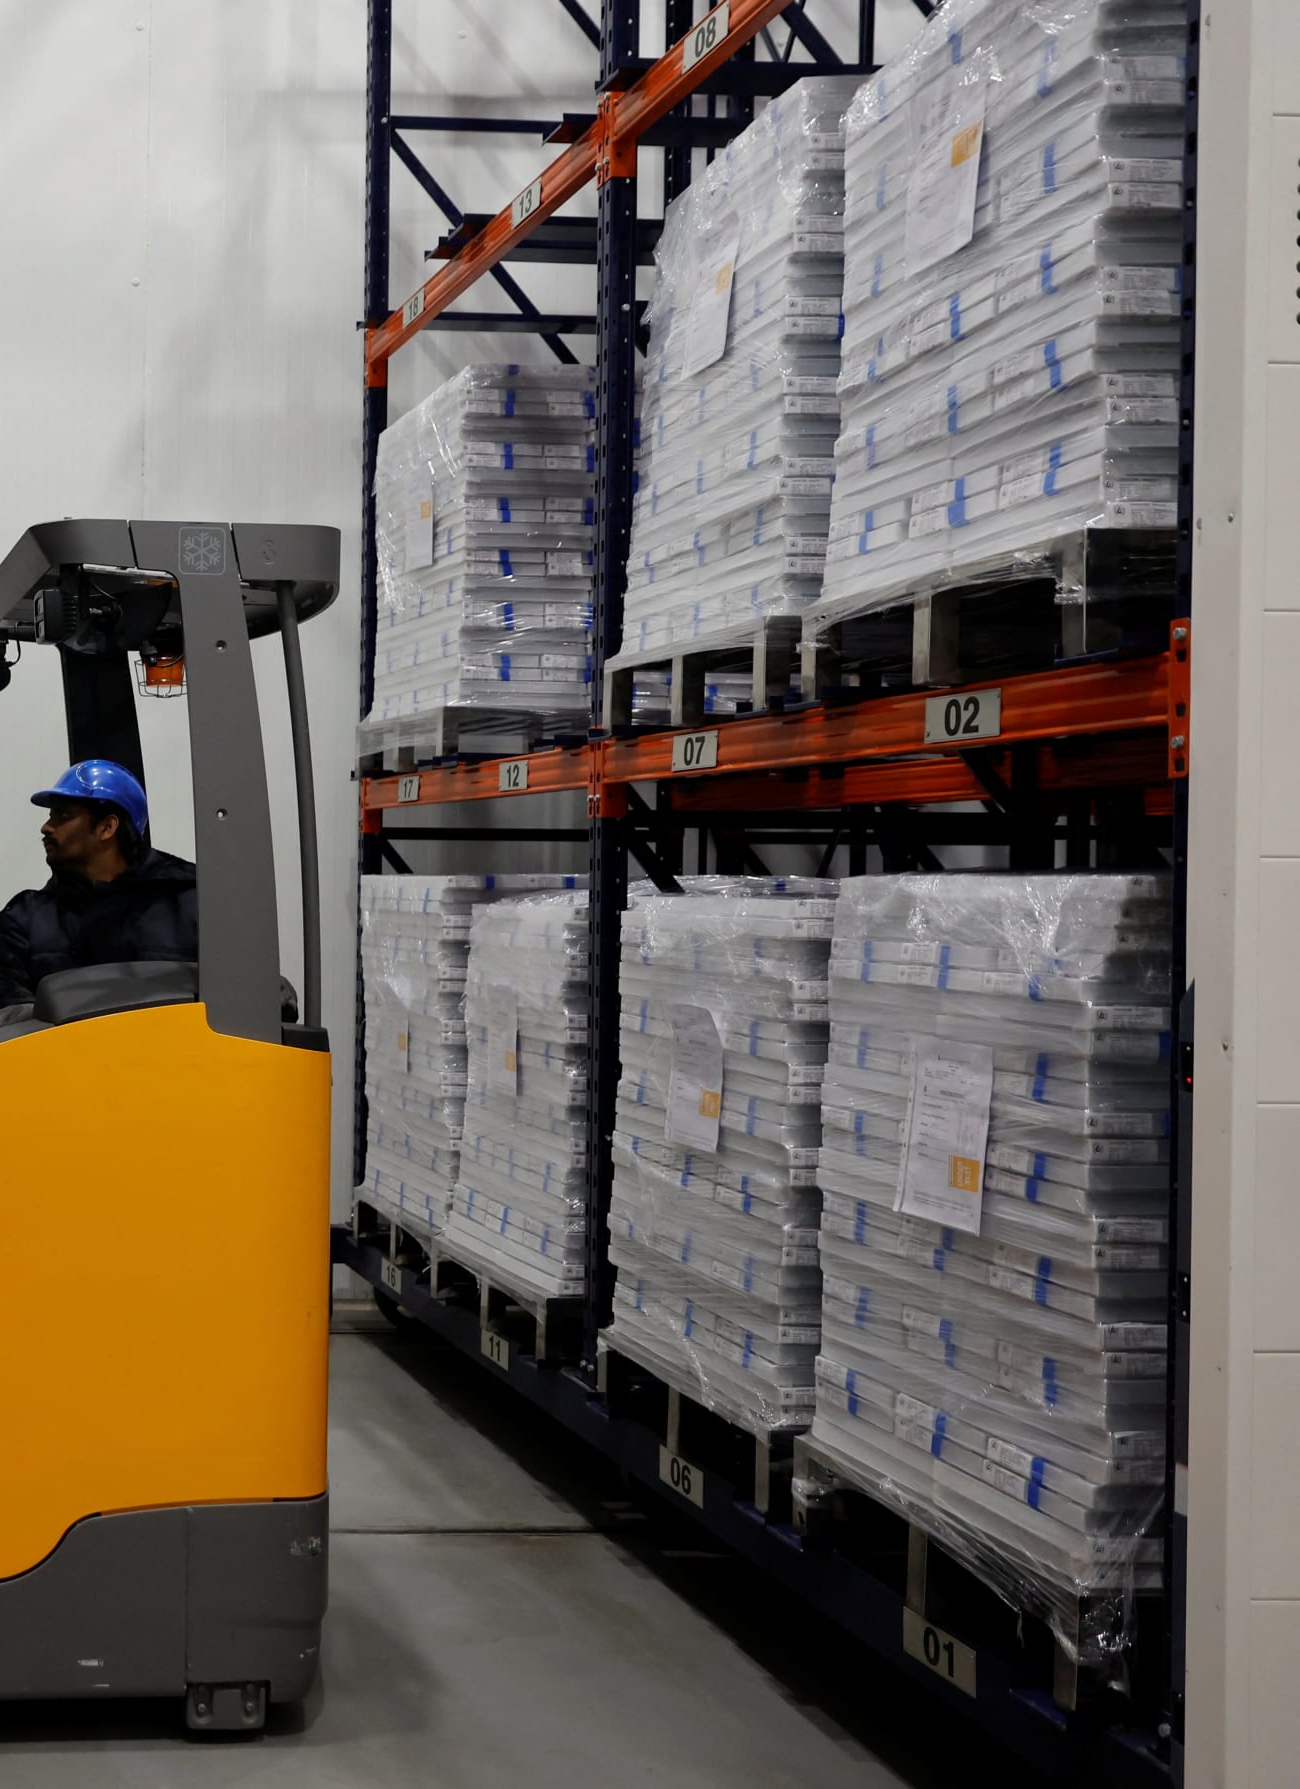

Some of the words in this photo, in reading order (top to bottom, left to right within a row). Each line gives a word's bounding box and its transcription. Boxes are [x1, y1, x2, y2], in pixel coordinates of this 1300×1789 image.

[695, 16, 716, 58] 08
[519, 188, 532, 218] 13
[409, 295, 419, 321] 18
[944, 695, 980, 737] 02
[683, 735, 706, 767] 07
[403, 778, 414, 799] 17
[506, 764, 520, 787] 12
[387, 1264, 396, 1288] 16
[489, 1335, 501, 1362] 11
[670, 1457, 691, 1496] 06
[923, 1626, 954, 1679] 01
